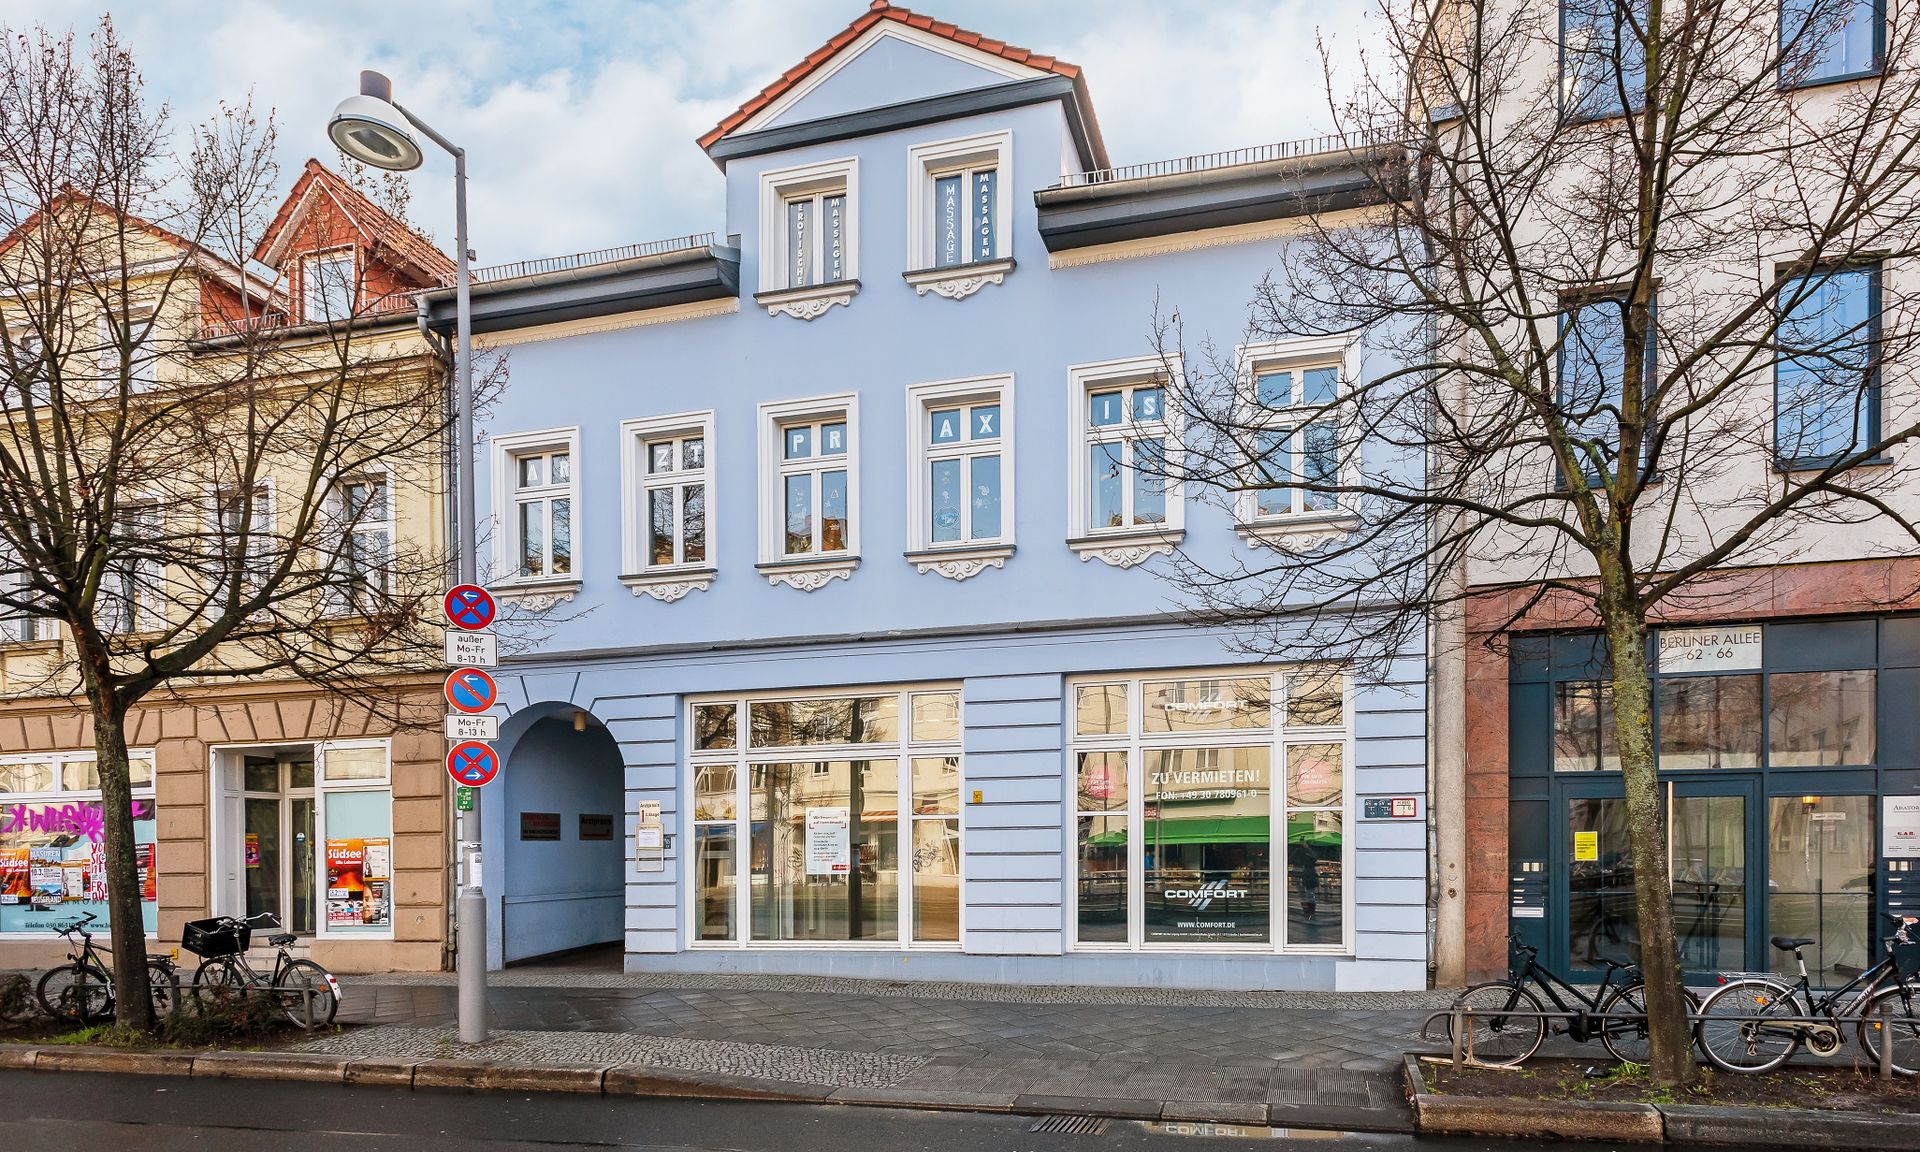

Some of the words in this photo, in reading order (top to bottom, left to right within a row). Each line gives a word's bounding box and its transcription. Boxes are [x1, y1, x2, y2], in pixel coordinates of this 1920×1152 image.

[980, 173, 990, 257] MASSAGEN
[946, 184, 955, 263] MASSAGE
[830, 198, 841, 279] MASSAGEN
[796, 203, 804, 286] EROTISCHE
[457, 635, 484, 644] außer
[1660, 635, 1720, 649] BERLINER
[1723, 632, 1761, 645] ALLEE
[456, 644, 486, 654] Mo-Fr
[1686, 648, 1703, 661] 62
[1716, 647, 1733, 659] 66
[456, 654, 477, 664] 8-13
[480, 655, 486, 664] h
[1164, 700, 1248, 711] COMFORT
[457, 718, 487, 727] Mo-Fr
[458, 728, 477, 737] 8-13
[480, 728, 486, 737] h
[1151, 772, 1170, 785] ZU
[1173, 769, 1260, 784] VERMIETEN!
[1155, 791, 1178, 800] FON:
[1200, 790, 1211, 799] 30
[1215, 789, 1257, 798] 780961-0
[328, 848, 362, 859] Südsee
[1164, 889, 1248, 899] COMFORT
[1177, 921, 1236, 929] WWW.COMFORT.DE
